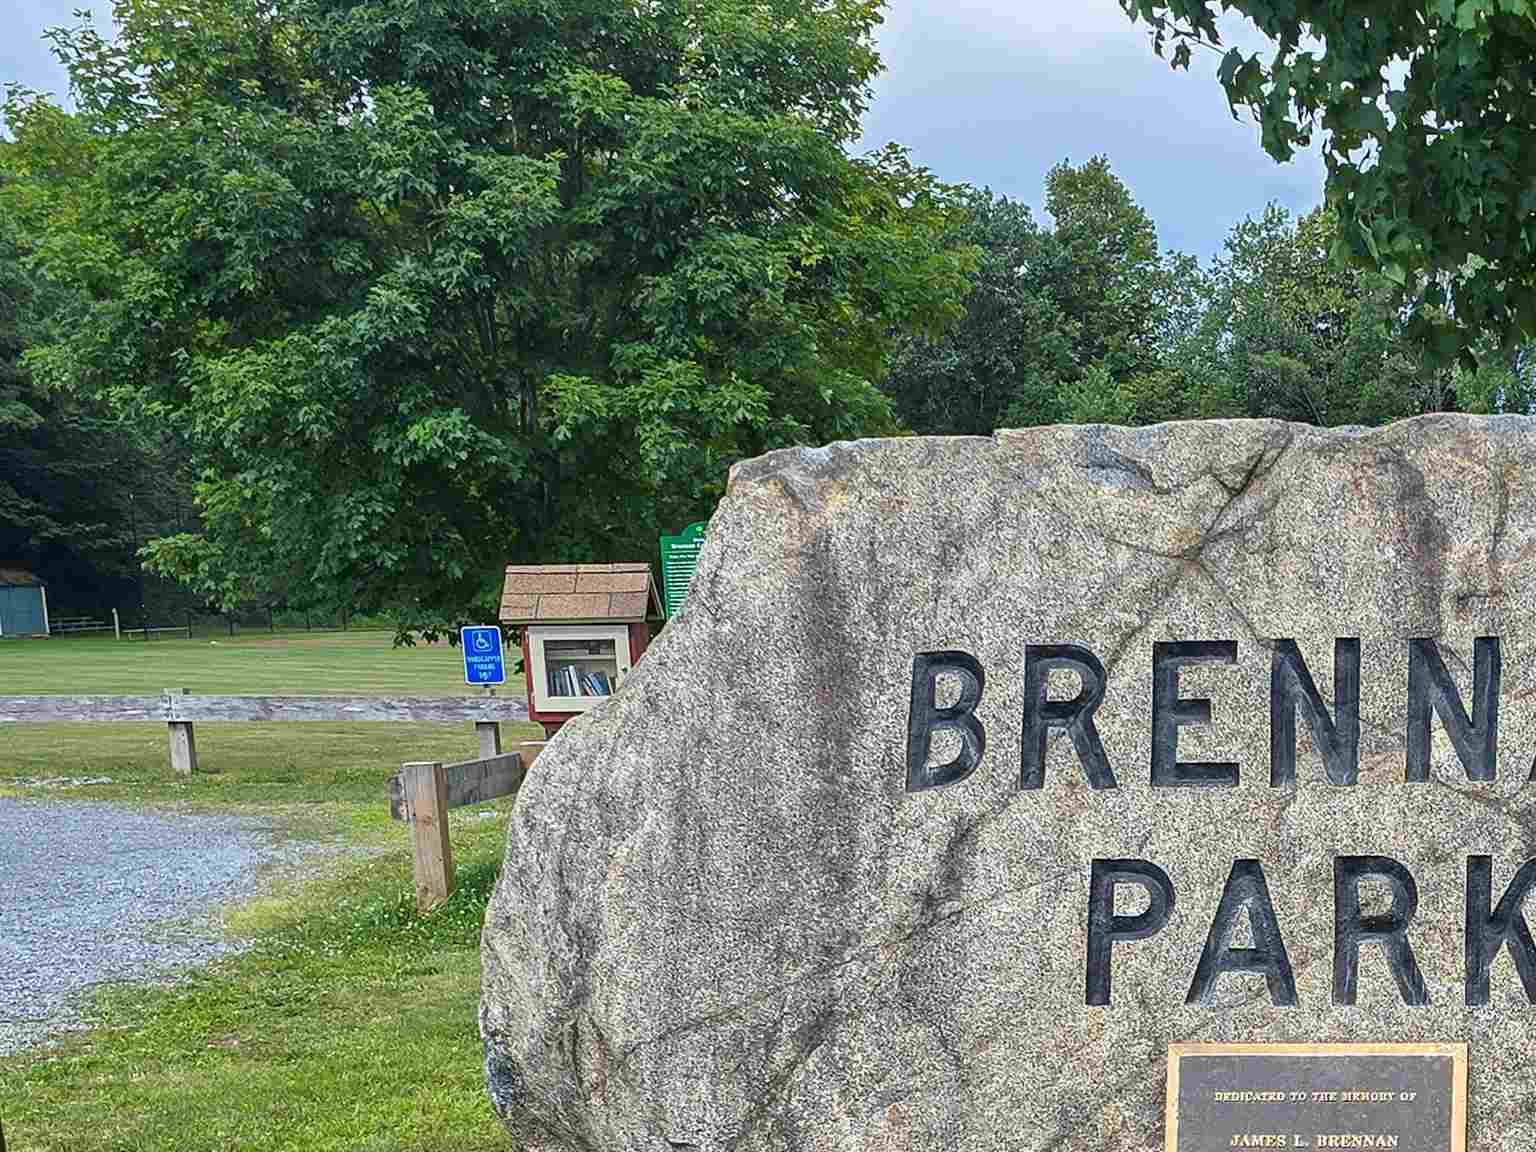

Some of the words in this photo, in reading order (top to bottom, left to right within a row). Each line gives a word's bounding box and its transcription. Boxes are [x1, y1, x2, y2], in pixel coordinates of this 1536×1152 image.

[1289, 1091, 1307, 1101] TO
[1311, 1091, 1337, 1101] THE
[1399, 1091, 1417, 1101] OF
[1229, 1134, 1287, 1148] JAMES
[1293, 1134, 1310, 1147] L.
[1316, 1134, 1400, 1148] BRENNAN
